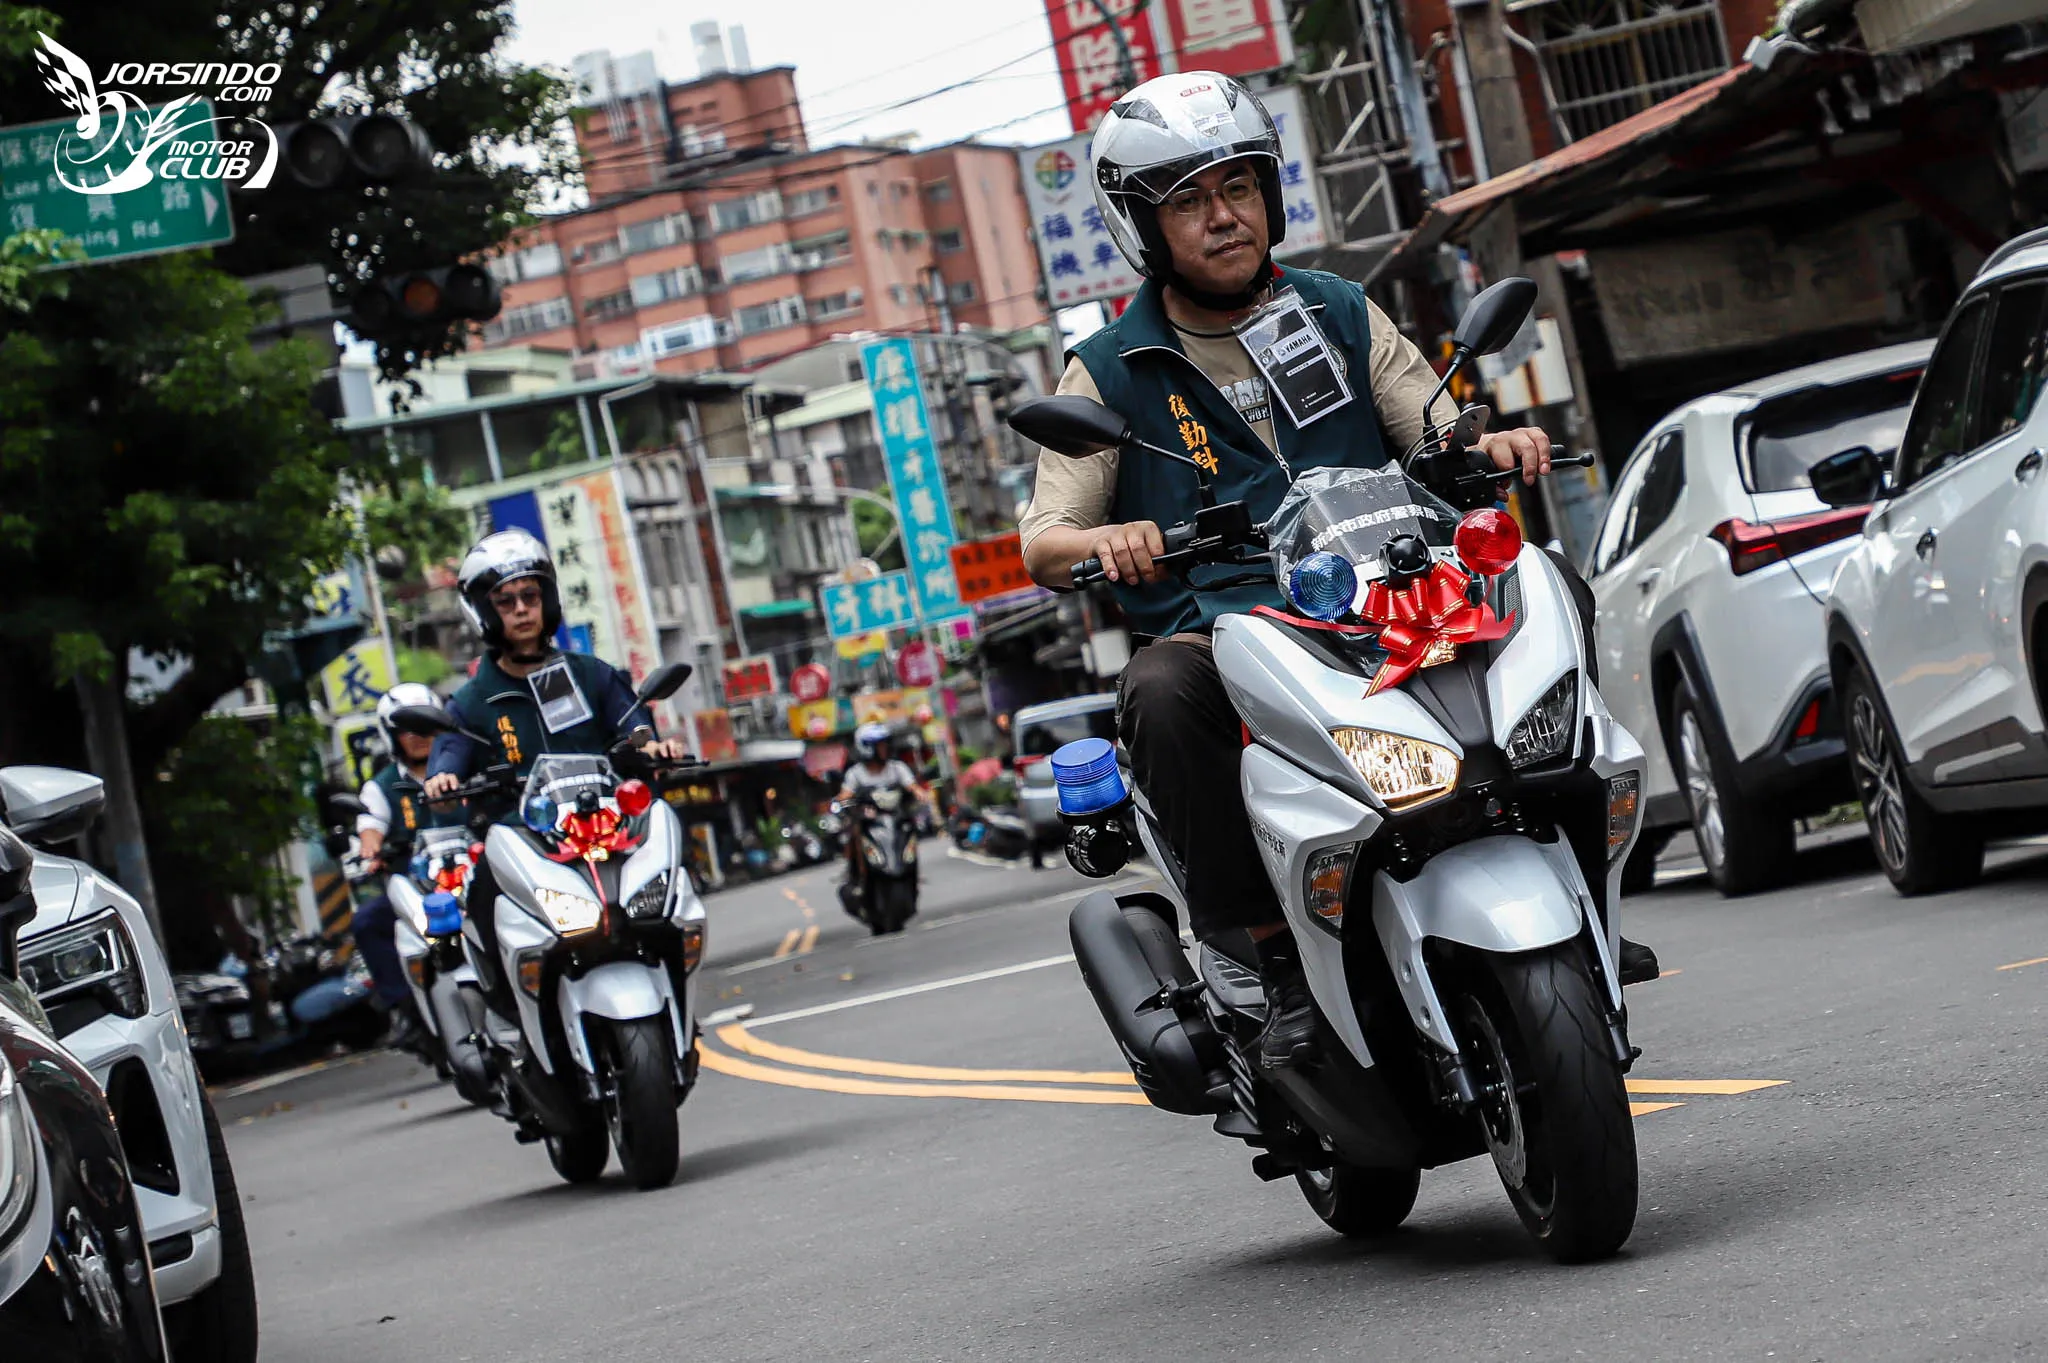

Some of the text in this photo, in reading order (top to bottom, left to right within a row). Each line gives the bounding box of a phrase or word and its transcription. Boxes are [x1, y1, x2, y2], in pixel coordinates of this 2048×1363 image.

[1285, 334, 1313, 353] YAMAHA
[1310, 503, 1439, 552] 新北市政府警察局
